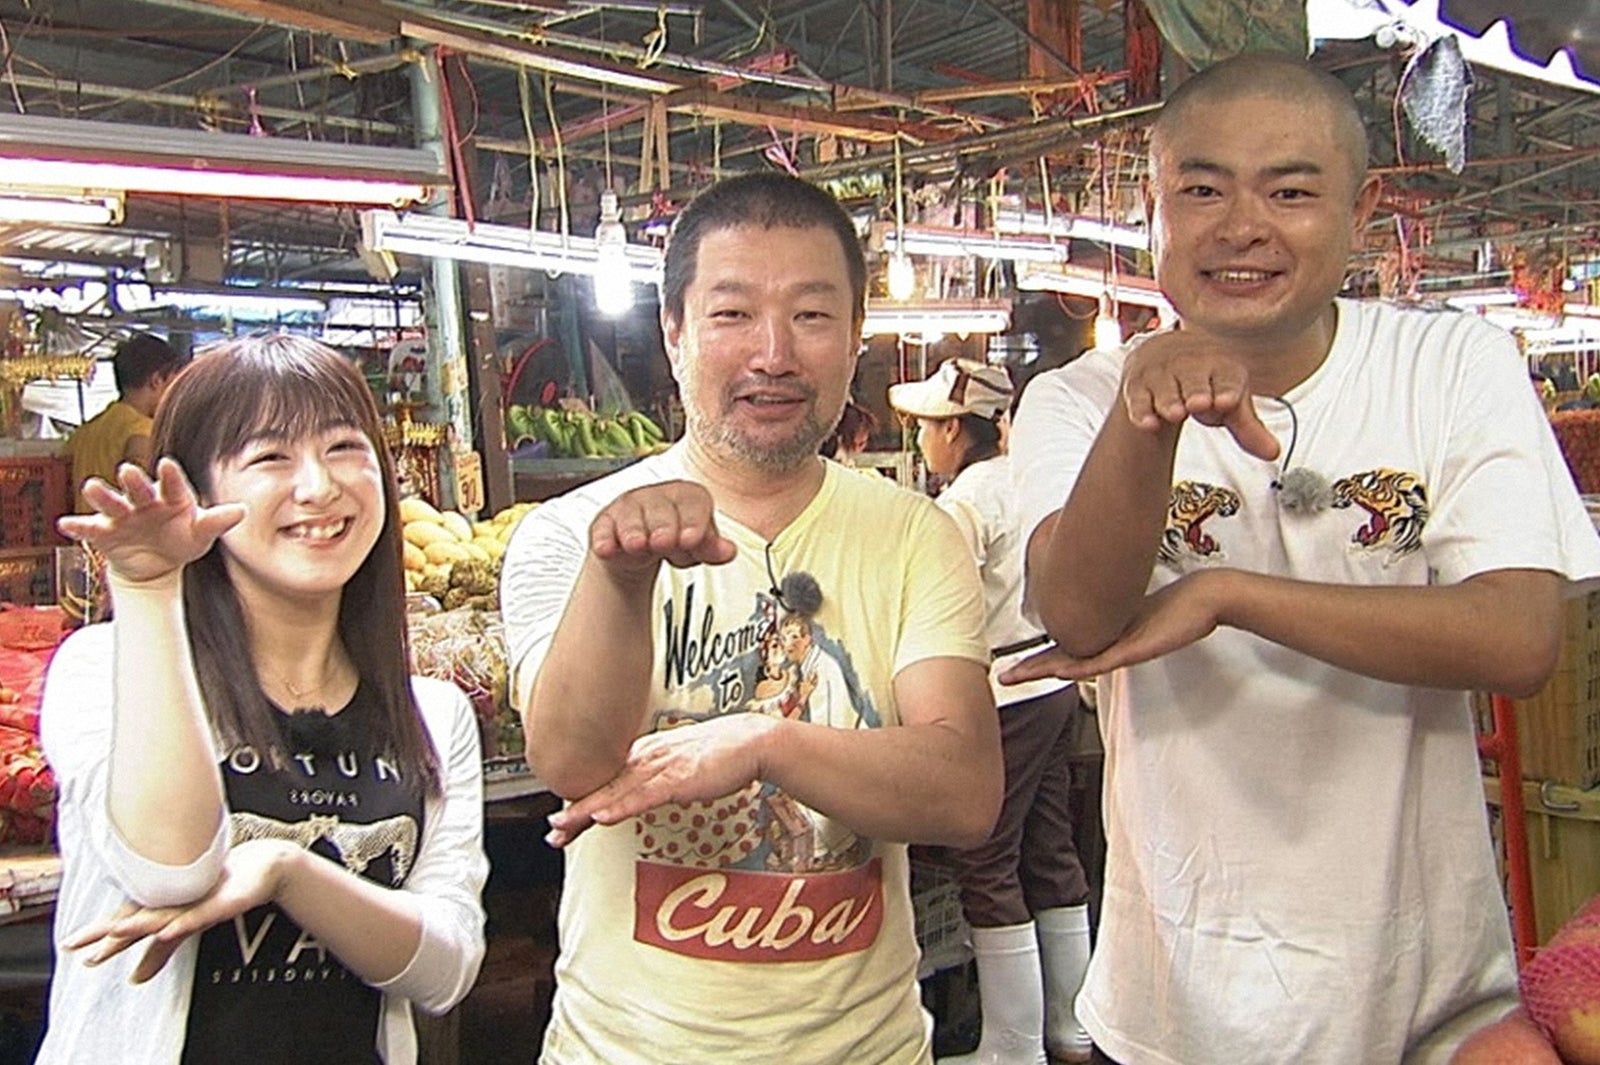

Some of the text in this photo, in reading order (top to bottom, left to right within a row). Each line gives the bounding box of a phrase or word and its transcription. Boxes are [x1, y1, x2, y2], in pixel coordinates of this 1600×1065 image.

[663, 582, 770, 690] Welcome
[720, 673, 743, 709] to
[656, 873, 875, 949] Cuba
